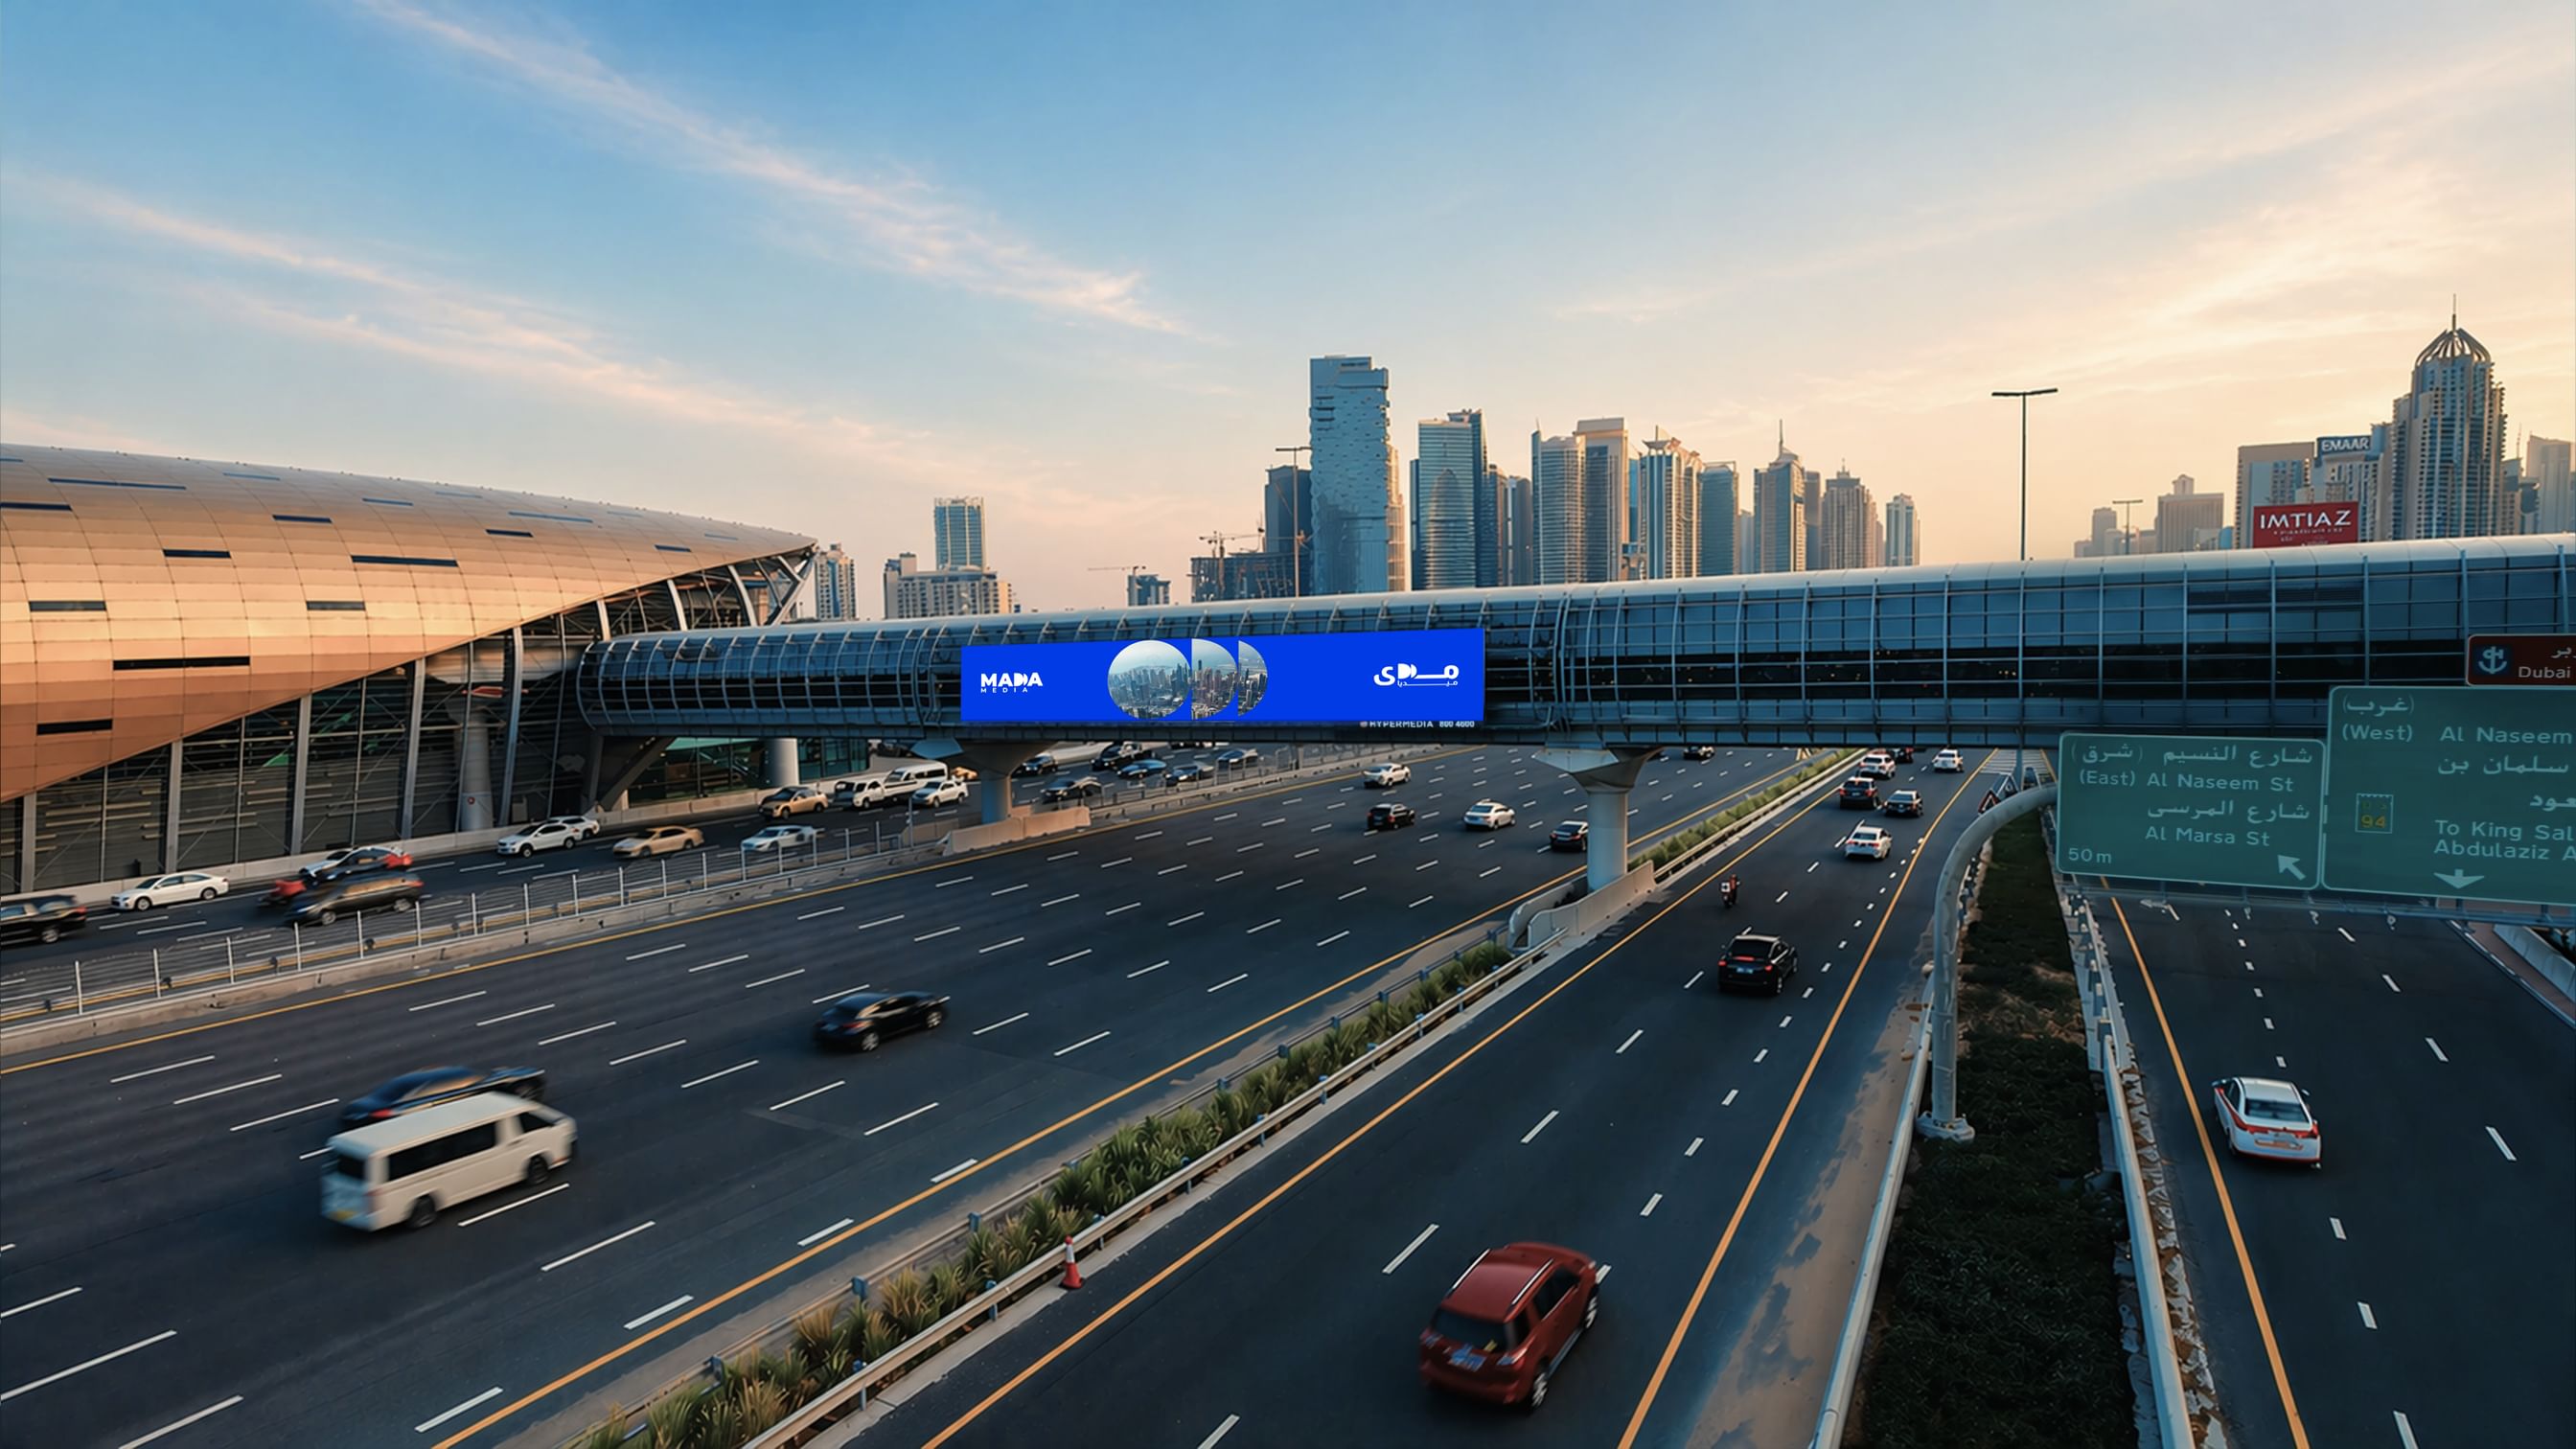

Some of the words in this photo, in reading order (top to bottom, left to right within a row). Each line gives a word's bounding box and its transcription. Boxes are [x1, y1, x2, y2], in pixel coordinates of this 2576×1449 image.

[2322, 437, 2370, 451] EMAAR
[2260, 510, 2352, 529] IMTIAZ
[980, 672, 1044, 687] MADA
[2518, 666, 2571, 678] Dubai
[2342, 724, 2413, 743] (West)
[2440, 726, 2465, 742] Al
[2476, 726, 2572, 745] Naseem
[2163, 745, 2237, 766] النسيم
[2249, 748, 2312, 768] شارع
[2483, 754, 2569, 774] سلمان
[2437, 758, 2470, 774] بن
[2080, 770, 2136, 788] (East)
[2147, 772, 2168, 788] Al
[2177, 773, 2259, 791] Naseem
[2270, 776, 2294, 793] St
[2148, 800, 2234, 819] المرسى
[2247, 803, 2310, 823] شارع
[2360, 814, 2386, 829] 94
[2434, 819, 2460, 836] To
[2472, 821, 2522, 841] King
[2145, 826, 2167, 841] Al
[2175, 827, 2236, 844] Marsa
[2245, 831, 2270, 847] St
[2433, 839, 2550, 861] Abdulaziz
